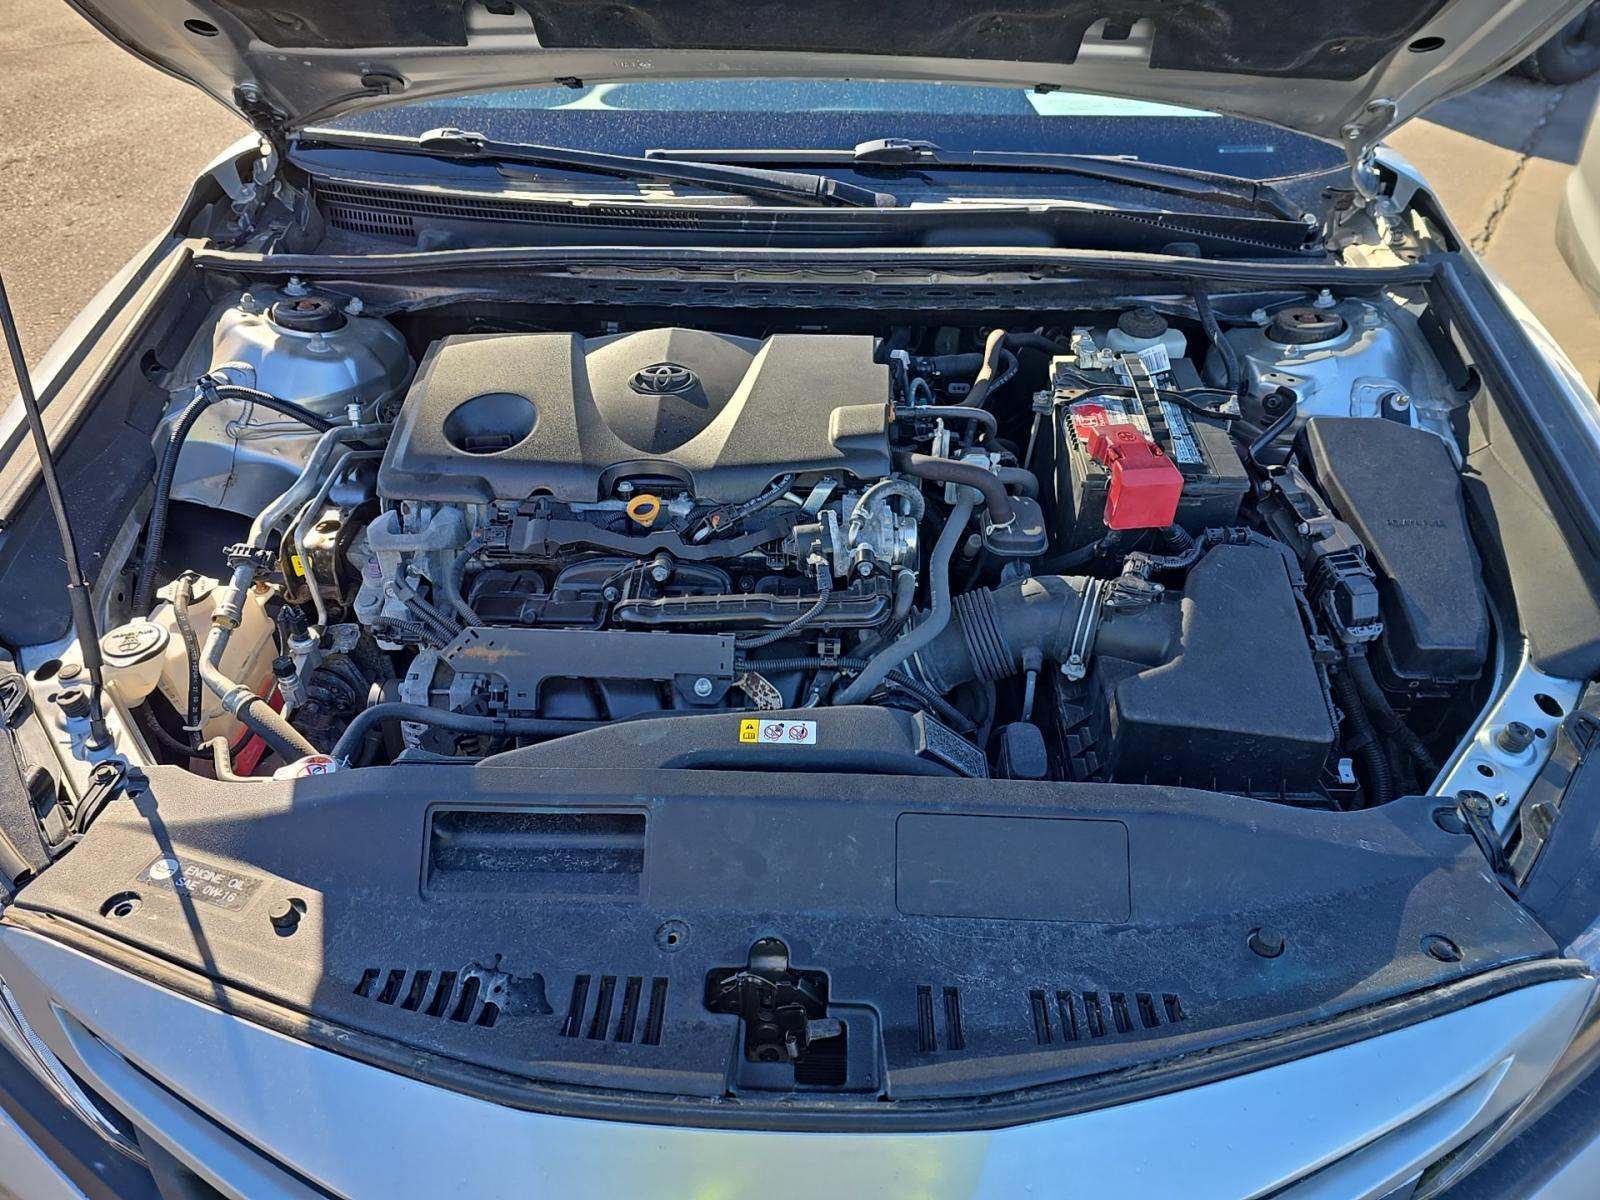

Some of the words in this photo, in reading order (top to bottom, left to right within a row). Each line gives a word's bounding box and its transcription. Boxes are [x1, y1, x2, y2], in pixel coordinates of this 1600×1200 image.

[176, 877, 199, 891] SAE
[202, 885, 237, 902] 0W-16
[185, 866, 225, 884] ENGINE
[228, 878, 244, 890] OIL
